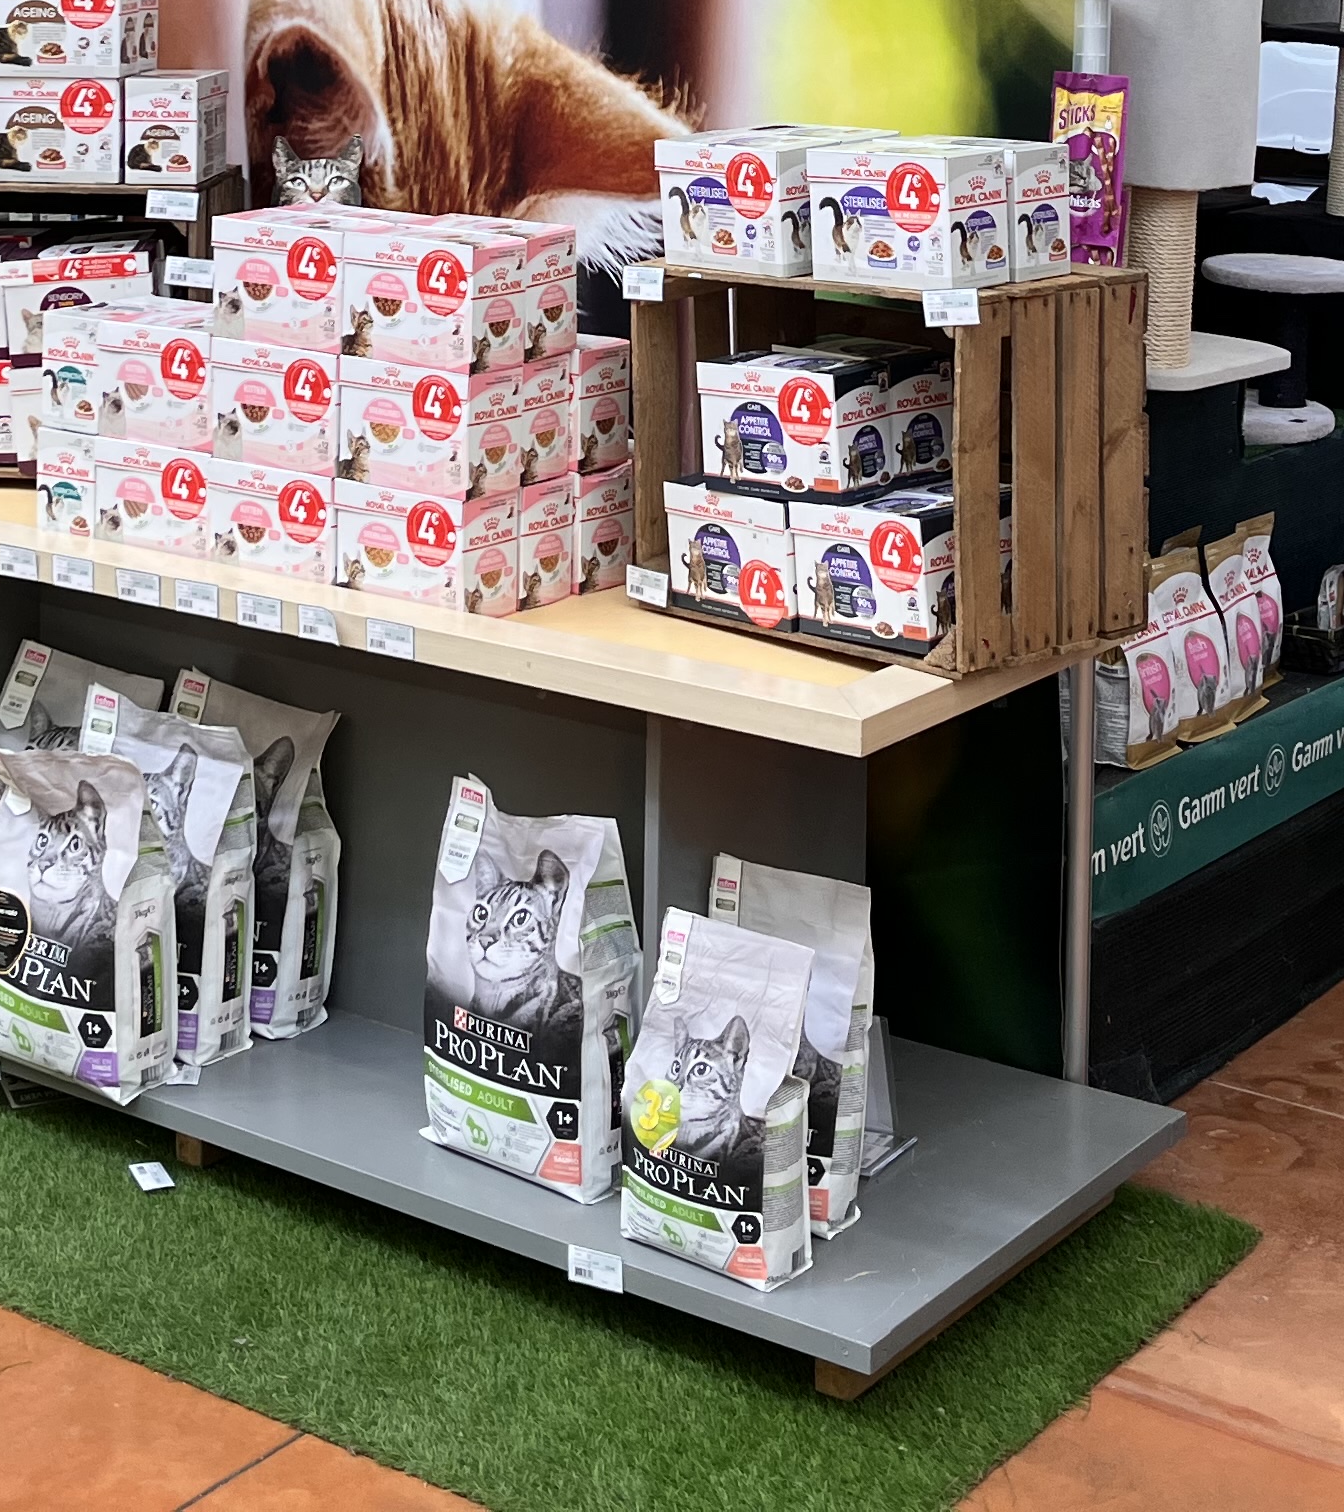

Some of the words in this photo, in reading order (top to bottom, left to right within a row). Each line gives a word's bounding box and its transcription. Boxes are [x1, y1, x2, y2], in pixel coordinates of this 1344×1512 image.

[13, 6, 56, 19] AGEING
[13, 111, 56, 124] AGEING
[1058, 103, 1096, 130] STICKS
[688, 185, 729, 200] STERILISED
[954, 193, 979, 205] ROYAL
[979, 189, 1003, 202] CANIN
[1022, 187, 1042, 198] ROYAL
[843, 195, 887, 210] STERILISED
[1067, 194, 1102, 209] hiskas
[896, 396, 922, 410] ROYAL
[922, 392, 949, 405] CANIN
[842, 408, 865, 423] ROYAL
[1103, 821, 1147, 870] vert
[1177, 789, 1227, 831] Gamm
[1228, 764, 1260, 802] vert
[1291, 733, 1334, 773] Gamm
[467, 1015, 527, 1050] PURINA
[427, 1059, 474, 1096] STERILISED
[476, 1091, 515, 1113] ADULT
[556, 1110, 574, 1126] 1+
[662, 1149, 715, 1176] PURINA
[671, 1201, 705, 1224] ADULT
[740, 1220, 755, 1234] 1+
